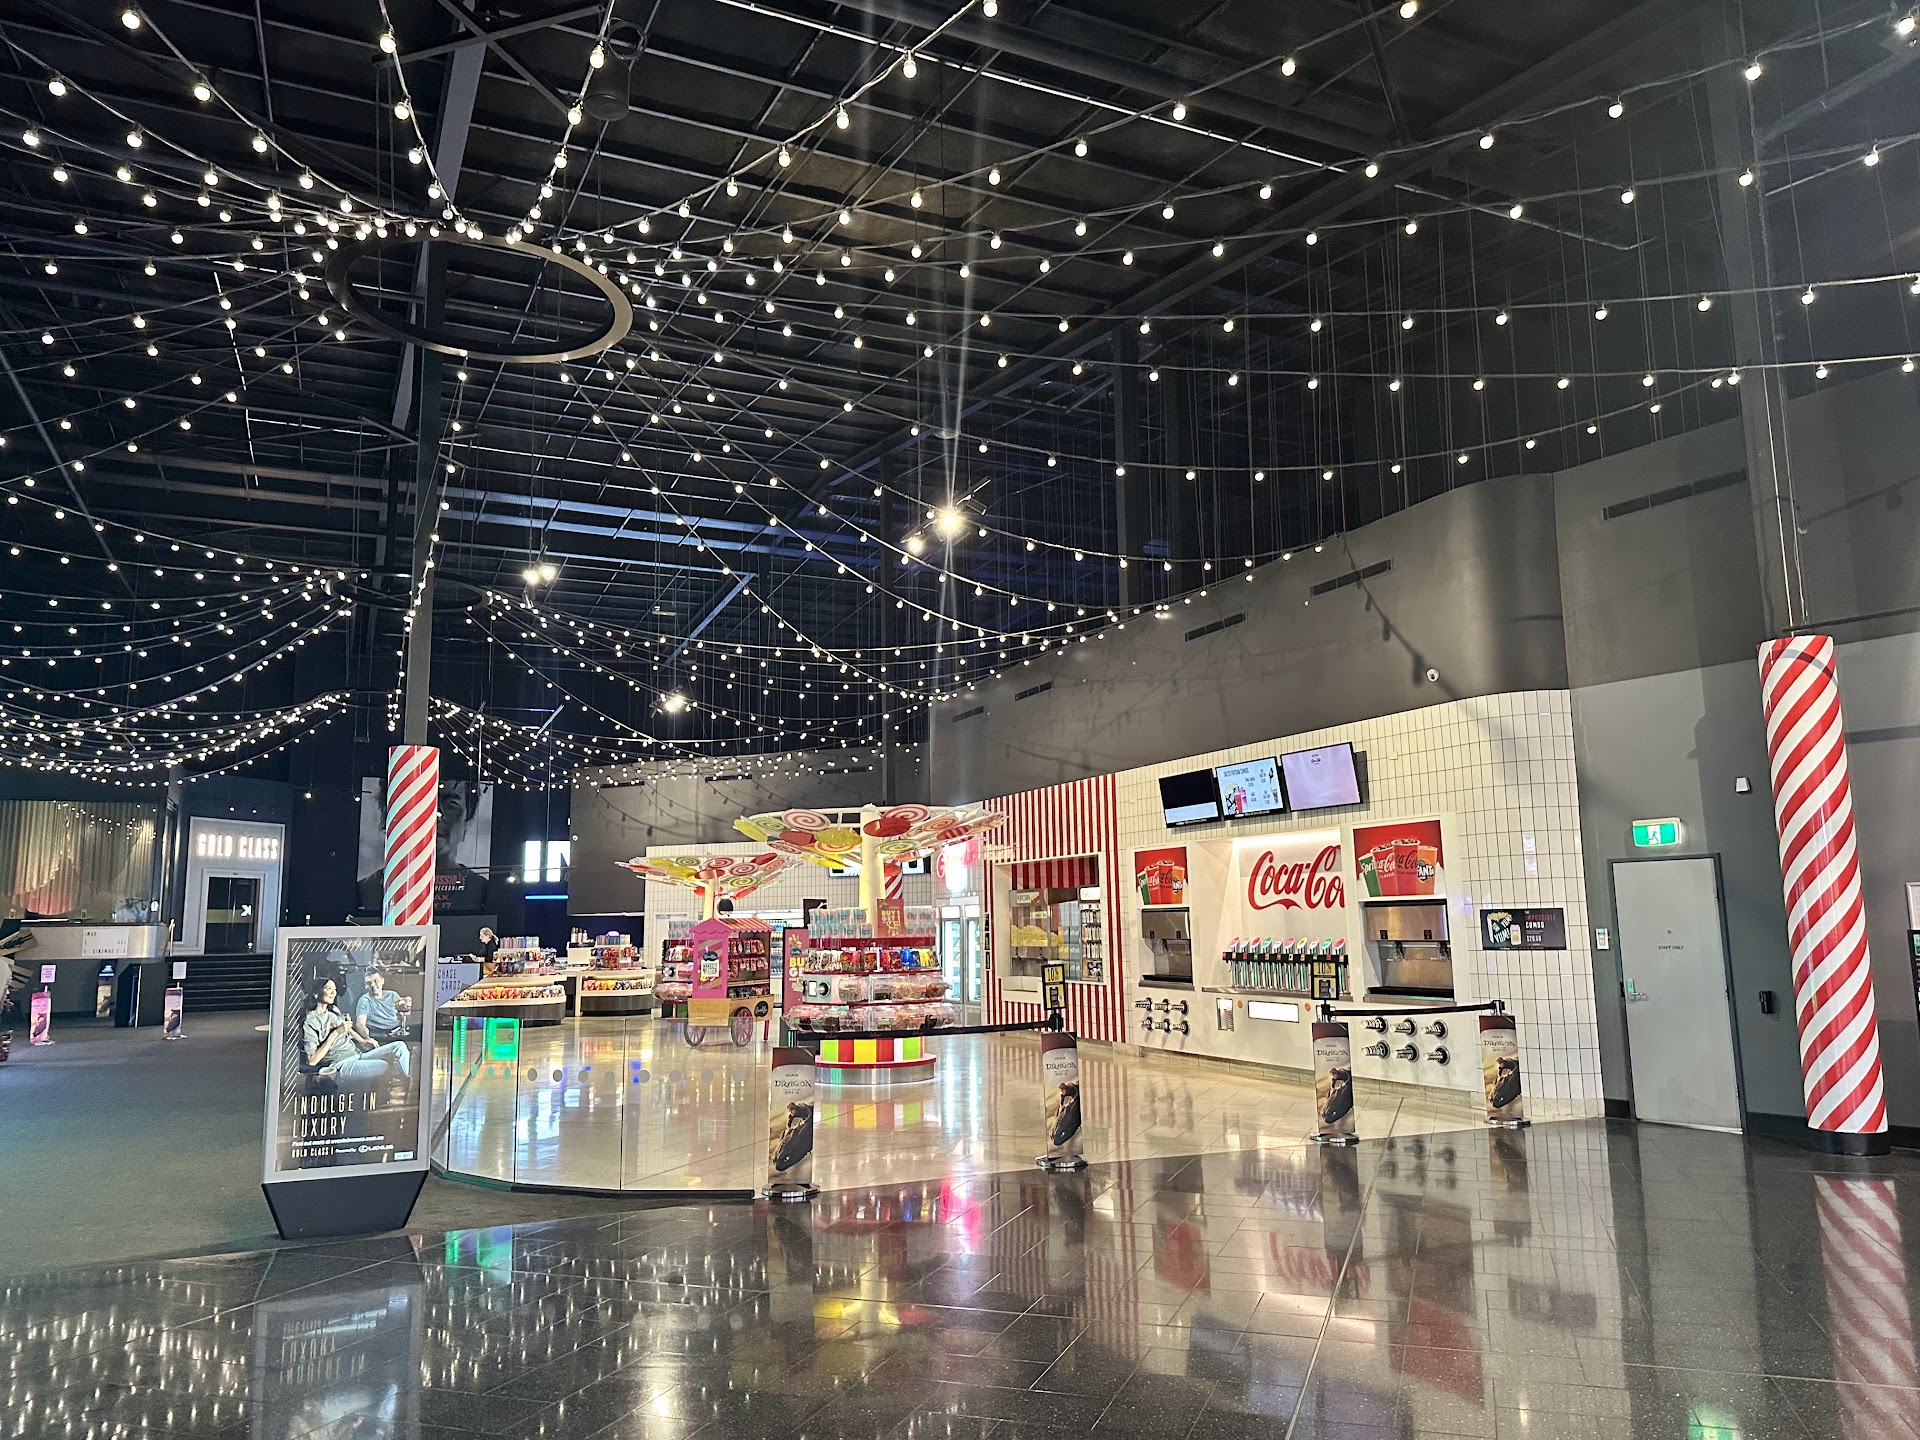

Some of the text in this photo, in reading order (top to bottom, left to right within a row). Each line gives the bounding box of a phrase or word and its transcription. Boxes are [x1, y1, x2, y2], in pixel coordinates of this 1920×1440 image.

[198, 833, 279, 860] GOLD CLASS
[442, 980, 460, 990] CARDS
[1046, 1062, 1077, 1070] DRAGON
[293, 1092, 376, 1115] INDULGE IN
[292, 1116, 347, 1138] LUXURY
[292, 1148, 307, 1158] GOLD
[310, 1147, 329, 1156] CLASS
